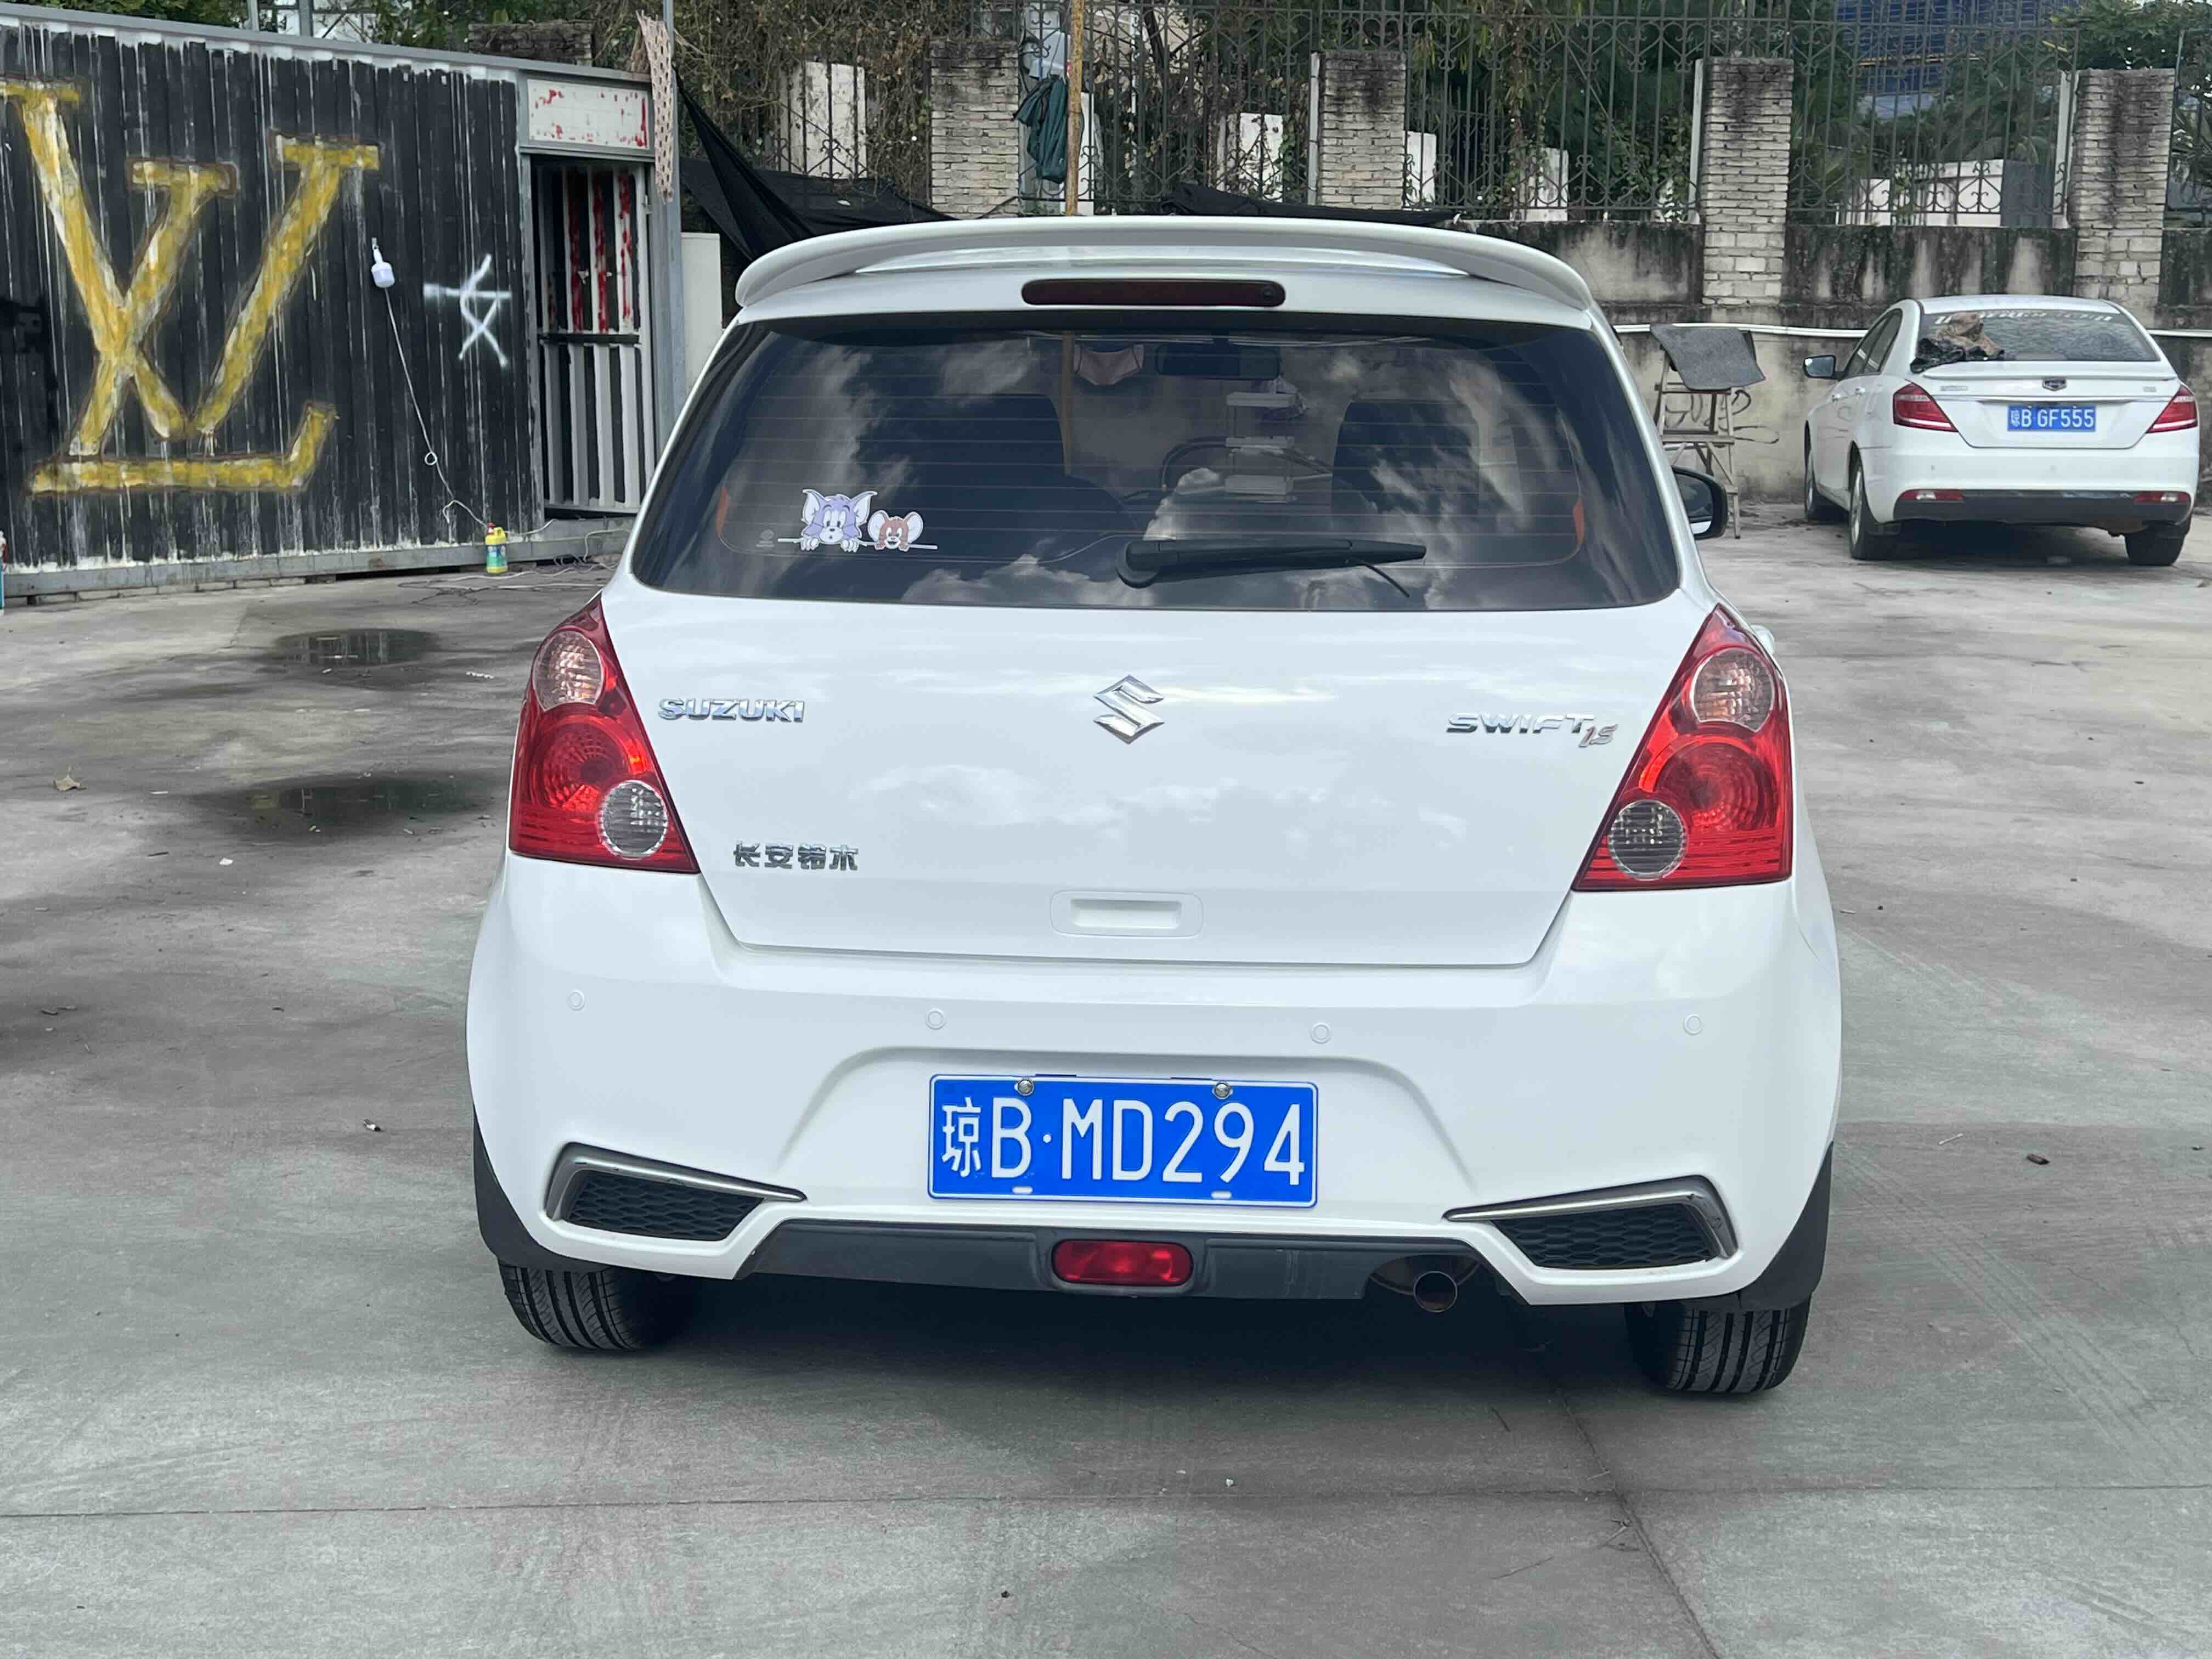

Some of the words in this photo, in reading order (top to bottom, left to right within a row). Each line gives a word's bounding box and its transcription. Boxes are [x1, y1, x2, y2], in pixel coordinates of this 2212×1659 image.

[658, 697, 805, 723] SUZUKI
[1446, 712, 1596, 734] SWIFT
[733, 840, 859, 871] 长安铃木
